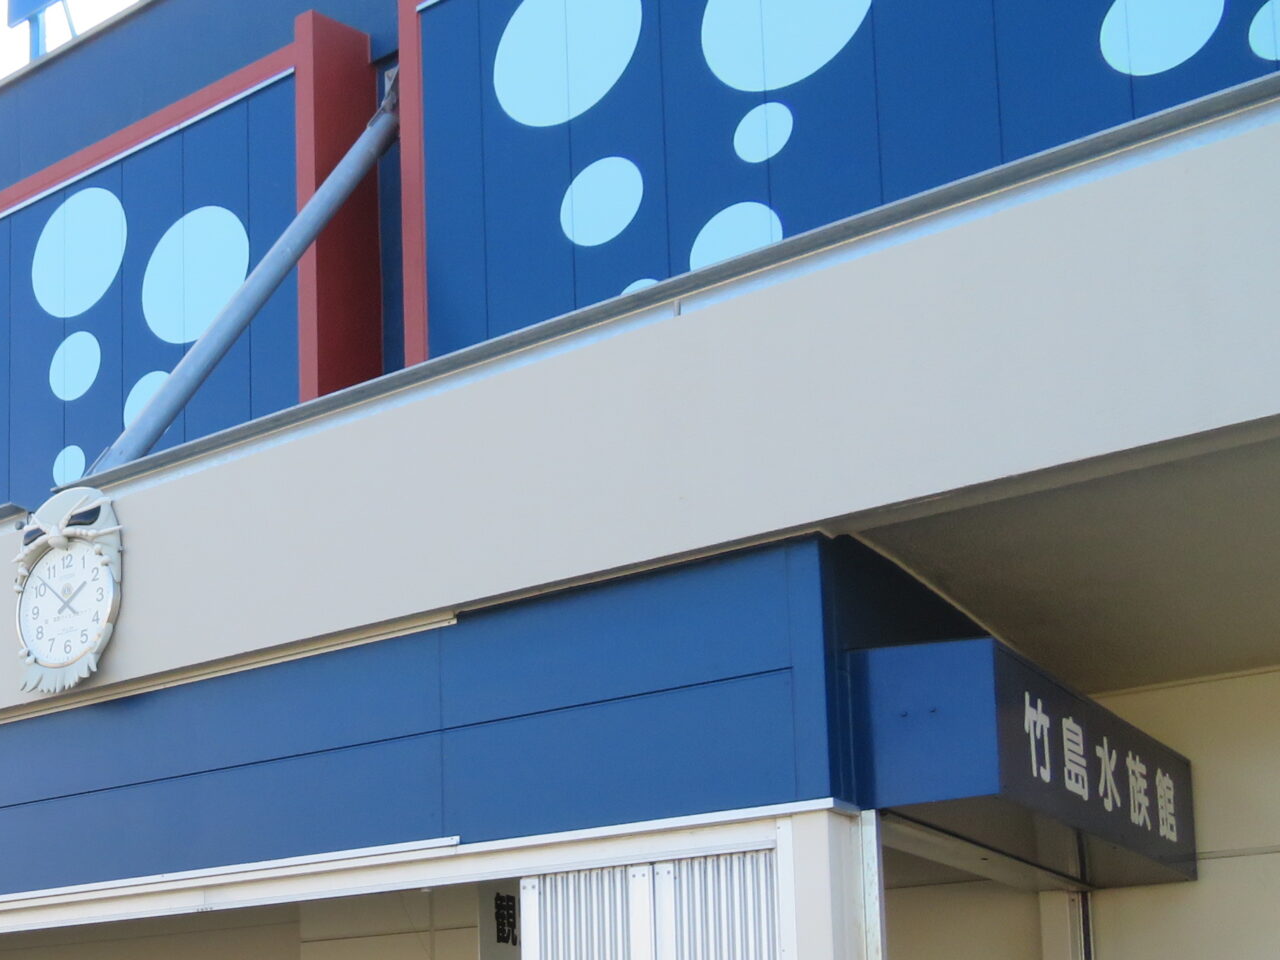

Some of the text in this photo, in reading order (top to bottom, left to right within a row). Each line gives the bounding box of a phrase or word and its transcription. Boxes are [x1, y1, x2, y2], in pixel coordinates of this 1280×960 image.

[61, 554, 73, 569] 12
[47, 565, 56, 580] 11
[91, 567, 99, 583] 2
[96, 587, 104, 602] 3
[32, 606, 39, 620] 9
[92, 611, 100, 625] 4
[36, 625, 44, 641] 8
[80, 629, 89, 644] 5
[48, 638, 56, 653] 7
[64, 639, 72, 654] 6
[1024, 691, 1178, 843] 竹島水族館
[495, 892, 521, 946] 観
